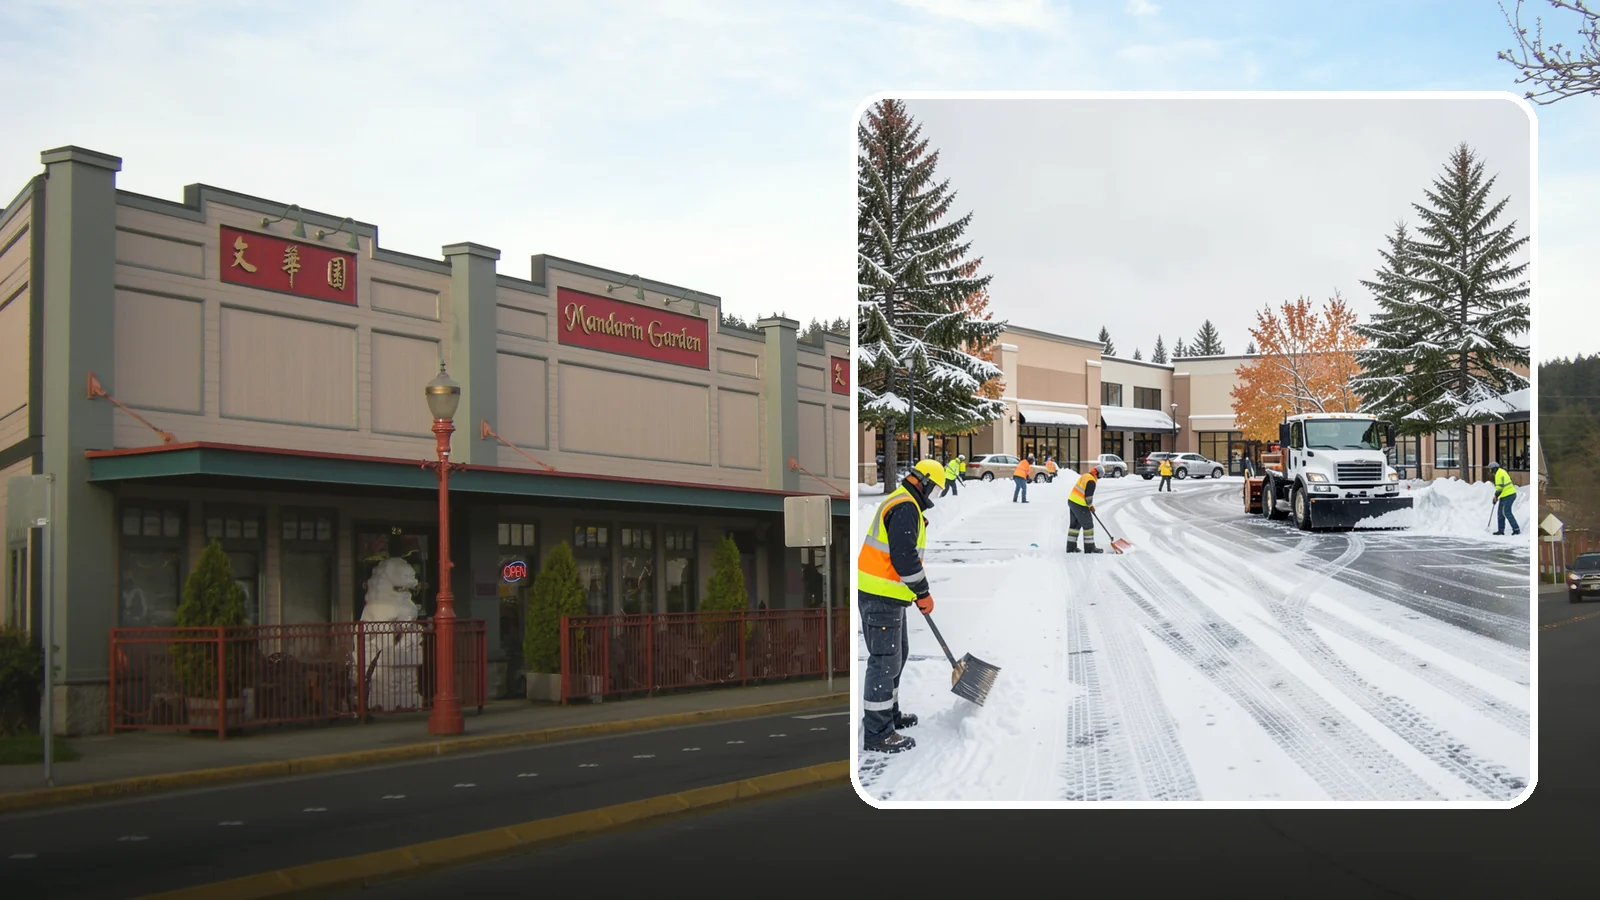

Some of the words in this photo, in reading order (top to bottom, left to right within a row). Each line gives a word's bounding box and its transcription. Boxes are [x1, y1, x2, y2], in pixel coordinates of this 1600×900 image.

[231, 236, 345, 289] 文華園
[565, 302, 643, 340] Mandarin
[648, 320, 701, 352] Garden
[503, 565, 527, 578] OPEN
